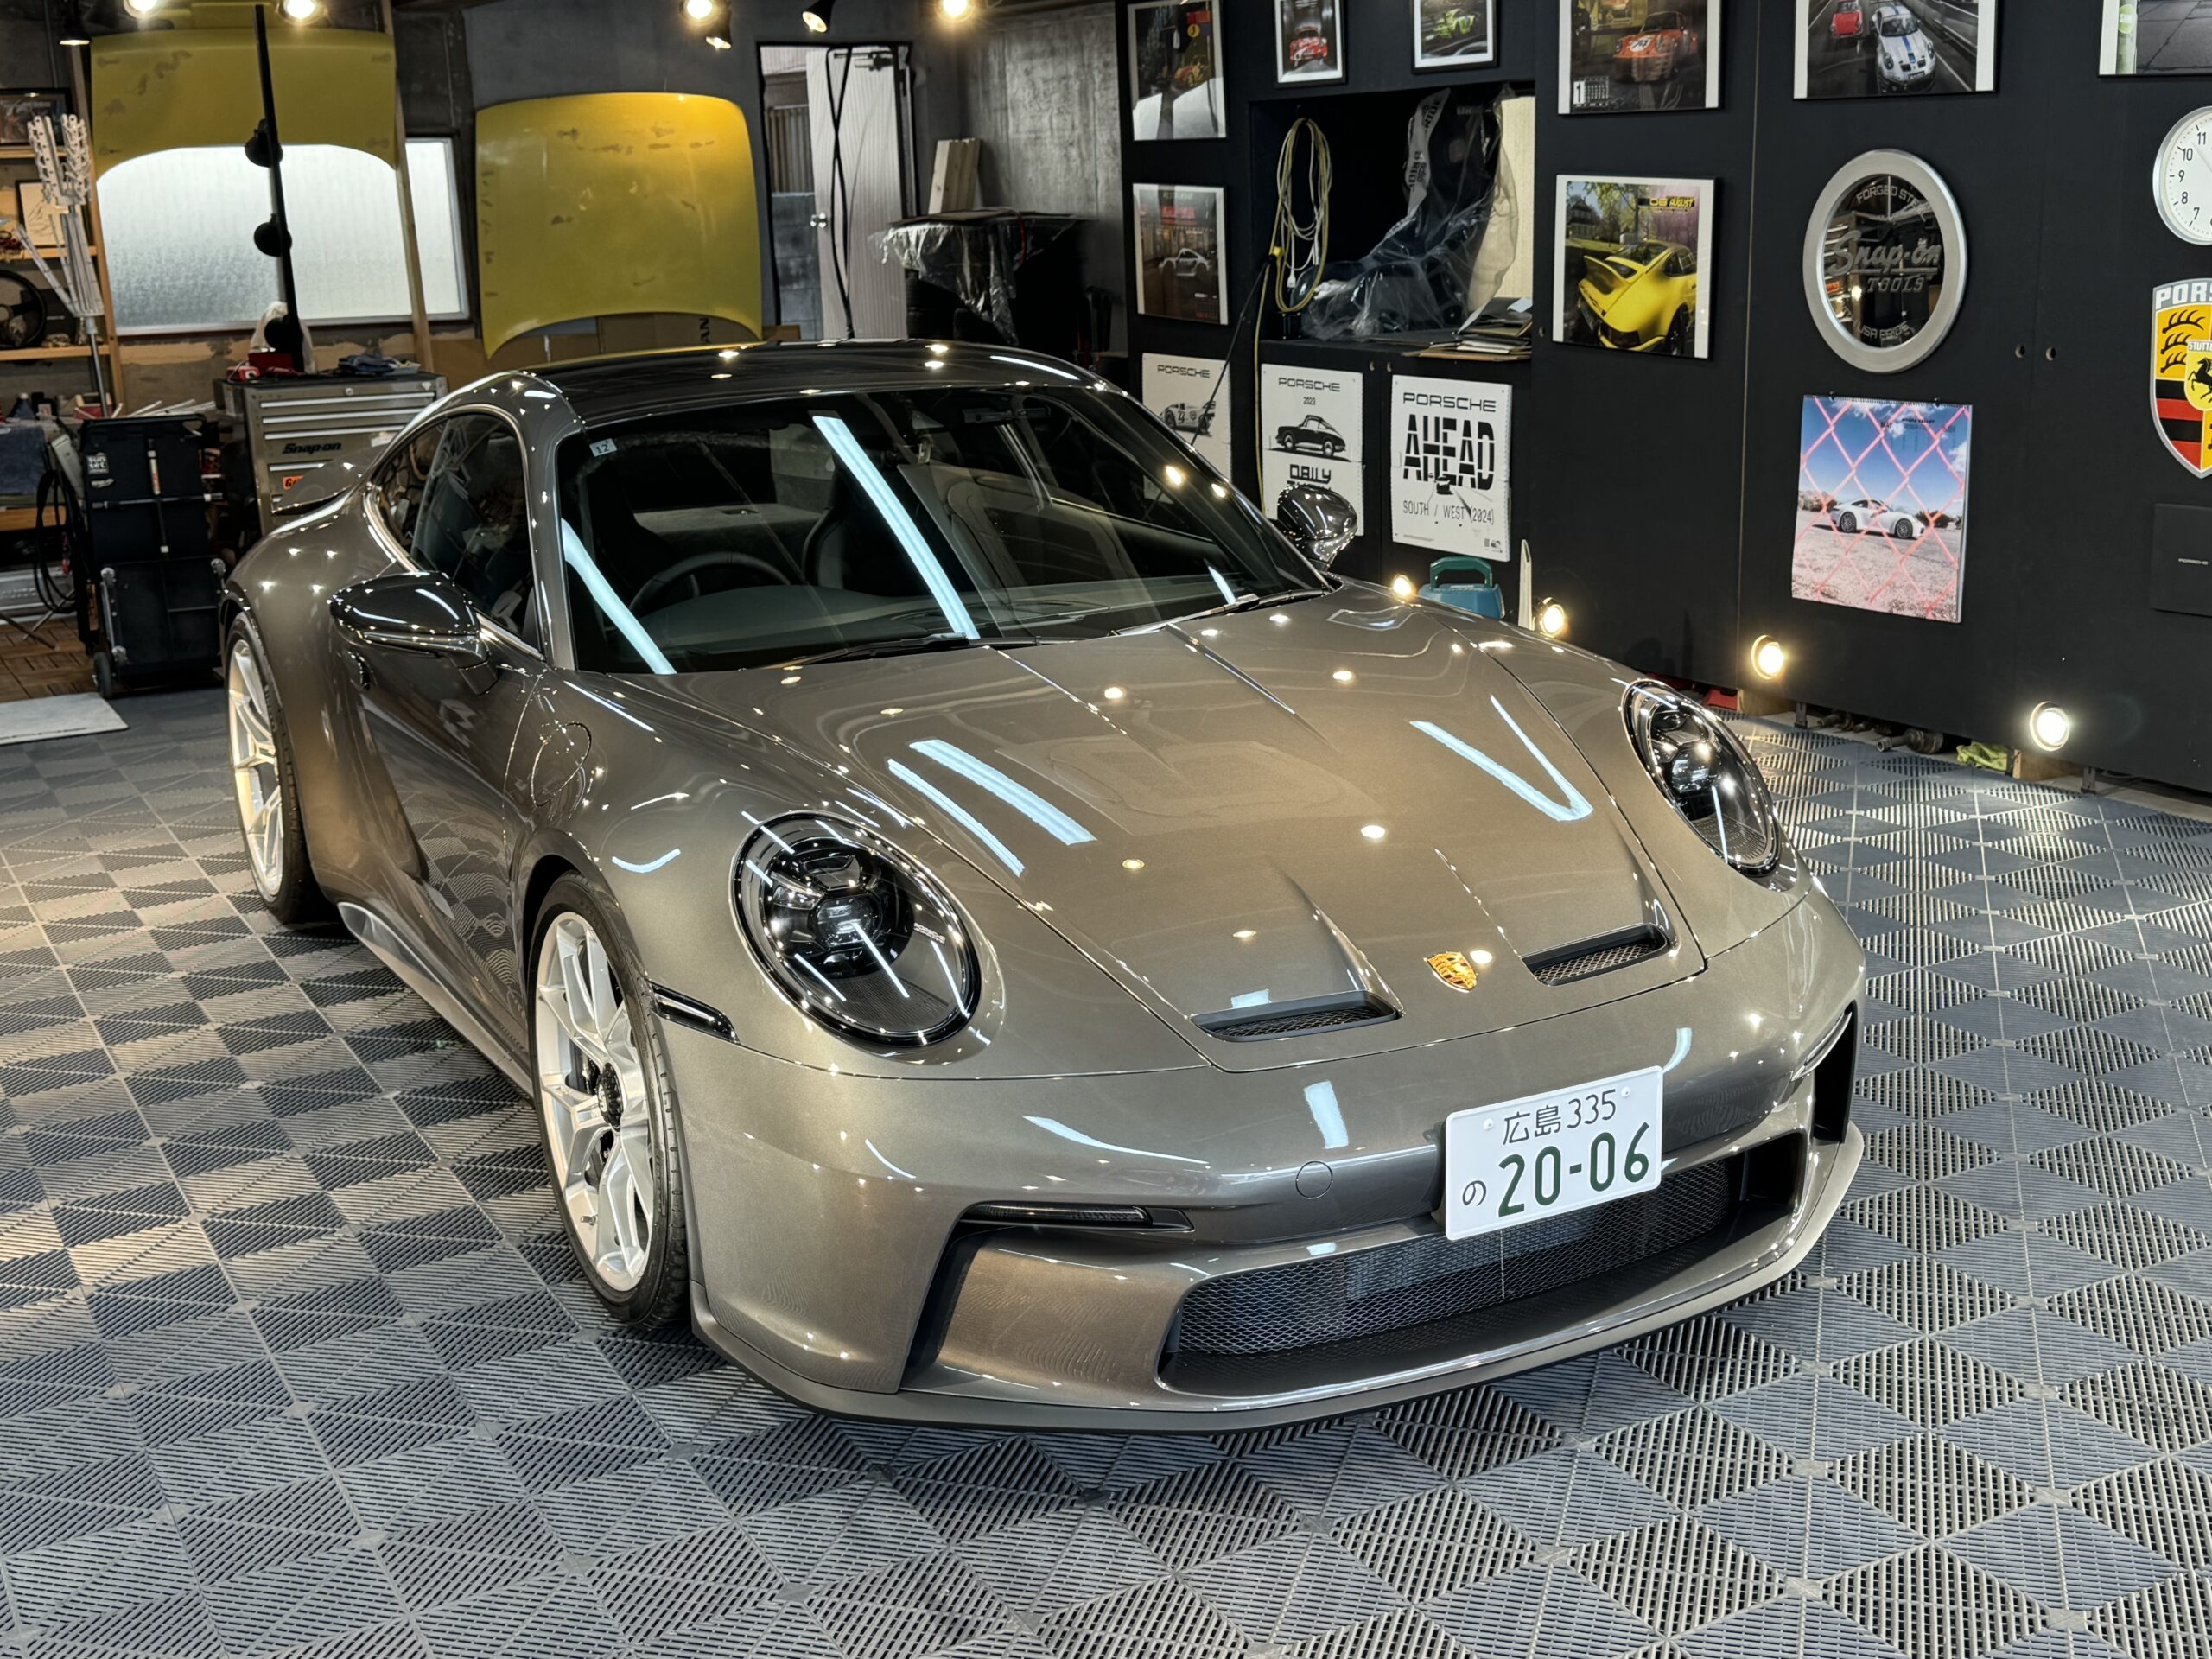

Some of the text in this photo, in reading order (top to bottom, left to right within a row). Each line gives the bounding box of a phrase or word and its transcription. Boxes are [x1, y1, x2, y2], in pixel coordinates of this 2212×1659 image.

[2197, 132, 2207, 145] 11
[2183, 148, 2193, 162] 10
[2178, 169, 2185, 183] 9
[1856, 184, 1898, 204] FORGED
[2181, 191, 2189, 205] 8
[1669, 198, 1694, 207] AUGUST
[2193, 207, 2200, 220] 7
[1824, 230, 1942, 276] Snap-on
[1867, 276, 1926, 293] TOOLS
[2155, 281, 2212, 310] POR
[1157, 364, 1211, 378] PORSCHE
[1278, 377, 1341, 392] PORSCHE
[1303, 396, 1316, 406] 2023
[1402, 391, 1497, 413] PORSCHE
[283, 442, 342, 455] Snap-on
[1402, 413, 1495, 491] AHEAD
[1403, 500, 1430, 517] SOUTH
[1443, 505, 1465, 520] WEST
[1469, 505, 1495, 526] (2024)
[1503, 1088, 1617, 1146] 広島 335
[1462, 1121, 1650, 1218] の 20-06
